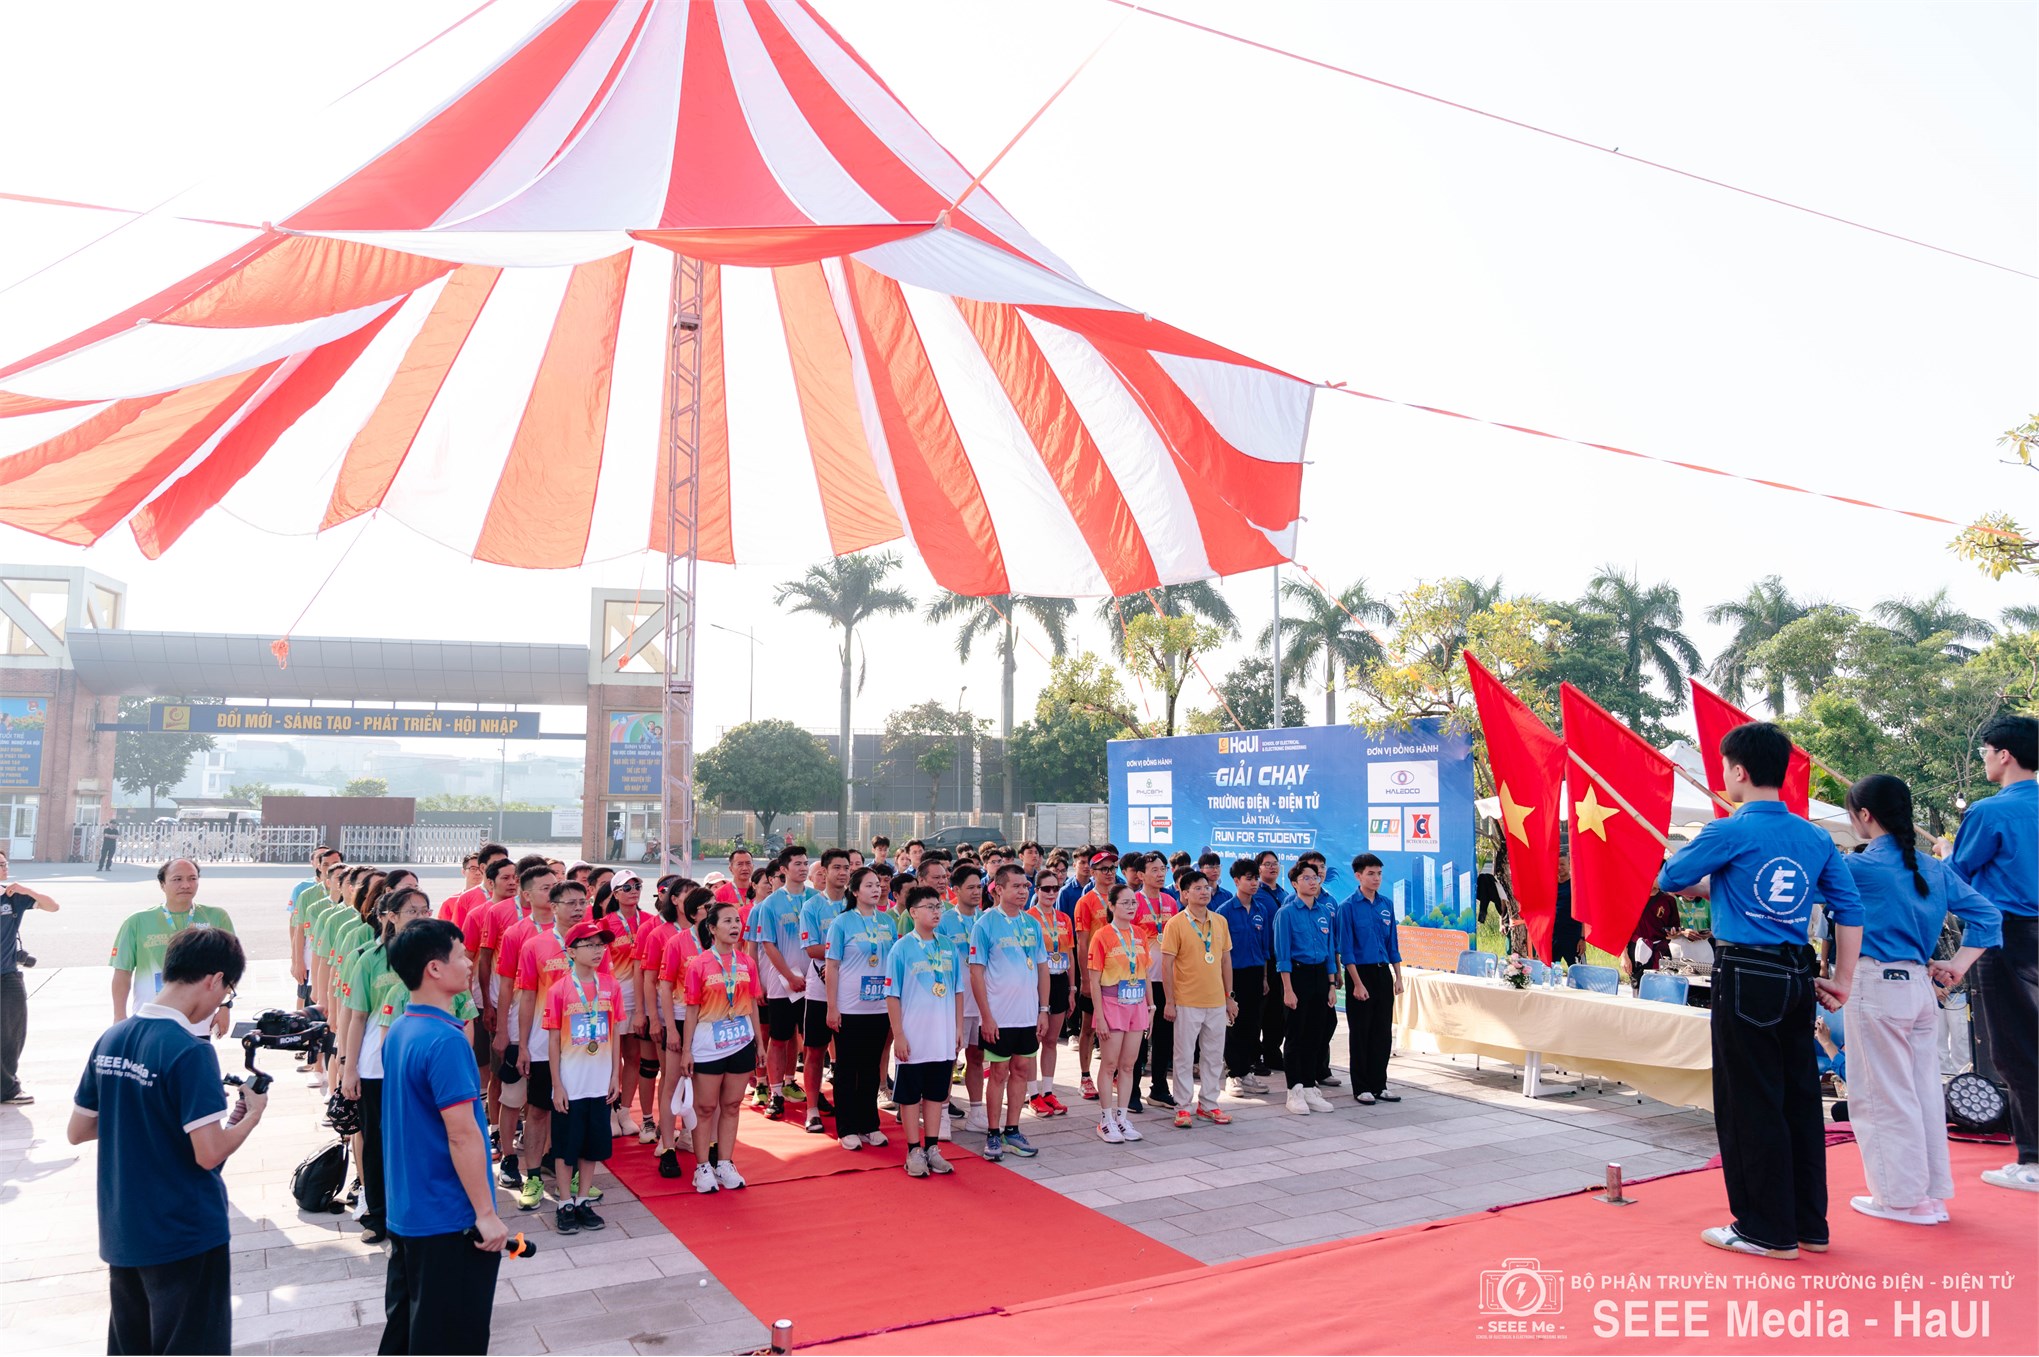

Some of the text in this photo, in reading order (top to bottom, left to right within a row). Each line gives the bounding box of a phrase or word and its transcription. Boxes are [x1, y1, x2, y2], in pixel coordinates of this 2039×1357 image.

[217, 707, 241, 728] ĐỔI
[244, 710, 273, 728] MỚI
[284, 712, 322, 730] SÁNG
[326, 715, 352, 733] TẠO
[363, 713, 399, 731] PHÁT
[403, 711, 442, 732] TRIỂN
[453, 715, 476, 735] HỘI
[480, 716, 519, 736] NHẬP
[1230, 735, 1259, 753] HaUI
[1366, 743, 1439, 756] ĐƠN VỊ ĐỒNG HÀNH
[1158, 758, 1172, 766] HÀNH
[1215, 759, 1310, 790] GIẢI CHẠY
[1207, 793, 1245, 809] TRƯỜNG
[1246, 792, 1270, 813] ĐIỆN
[1278, 792, 1303, 813] ĐIỆN
[1305, 791, 1320, 809] TỬ
[1241, 812, 1280, 825] LẦN THỨ 4
[1215, 830, 1311, 844] RUN FOR STUDENTS
[280, 1036, 302, 1044] RONIN
[719, 1025, 747, 1041] 2532
